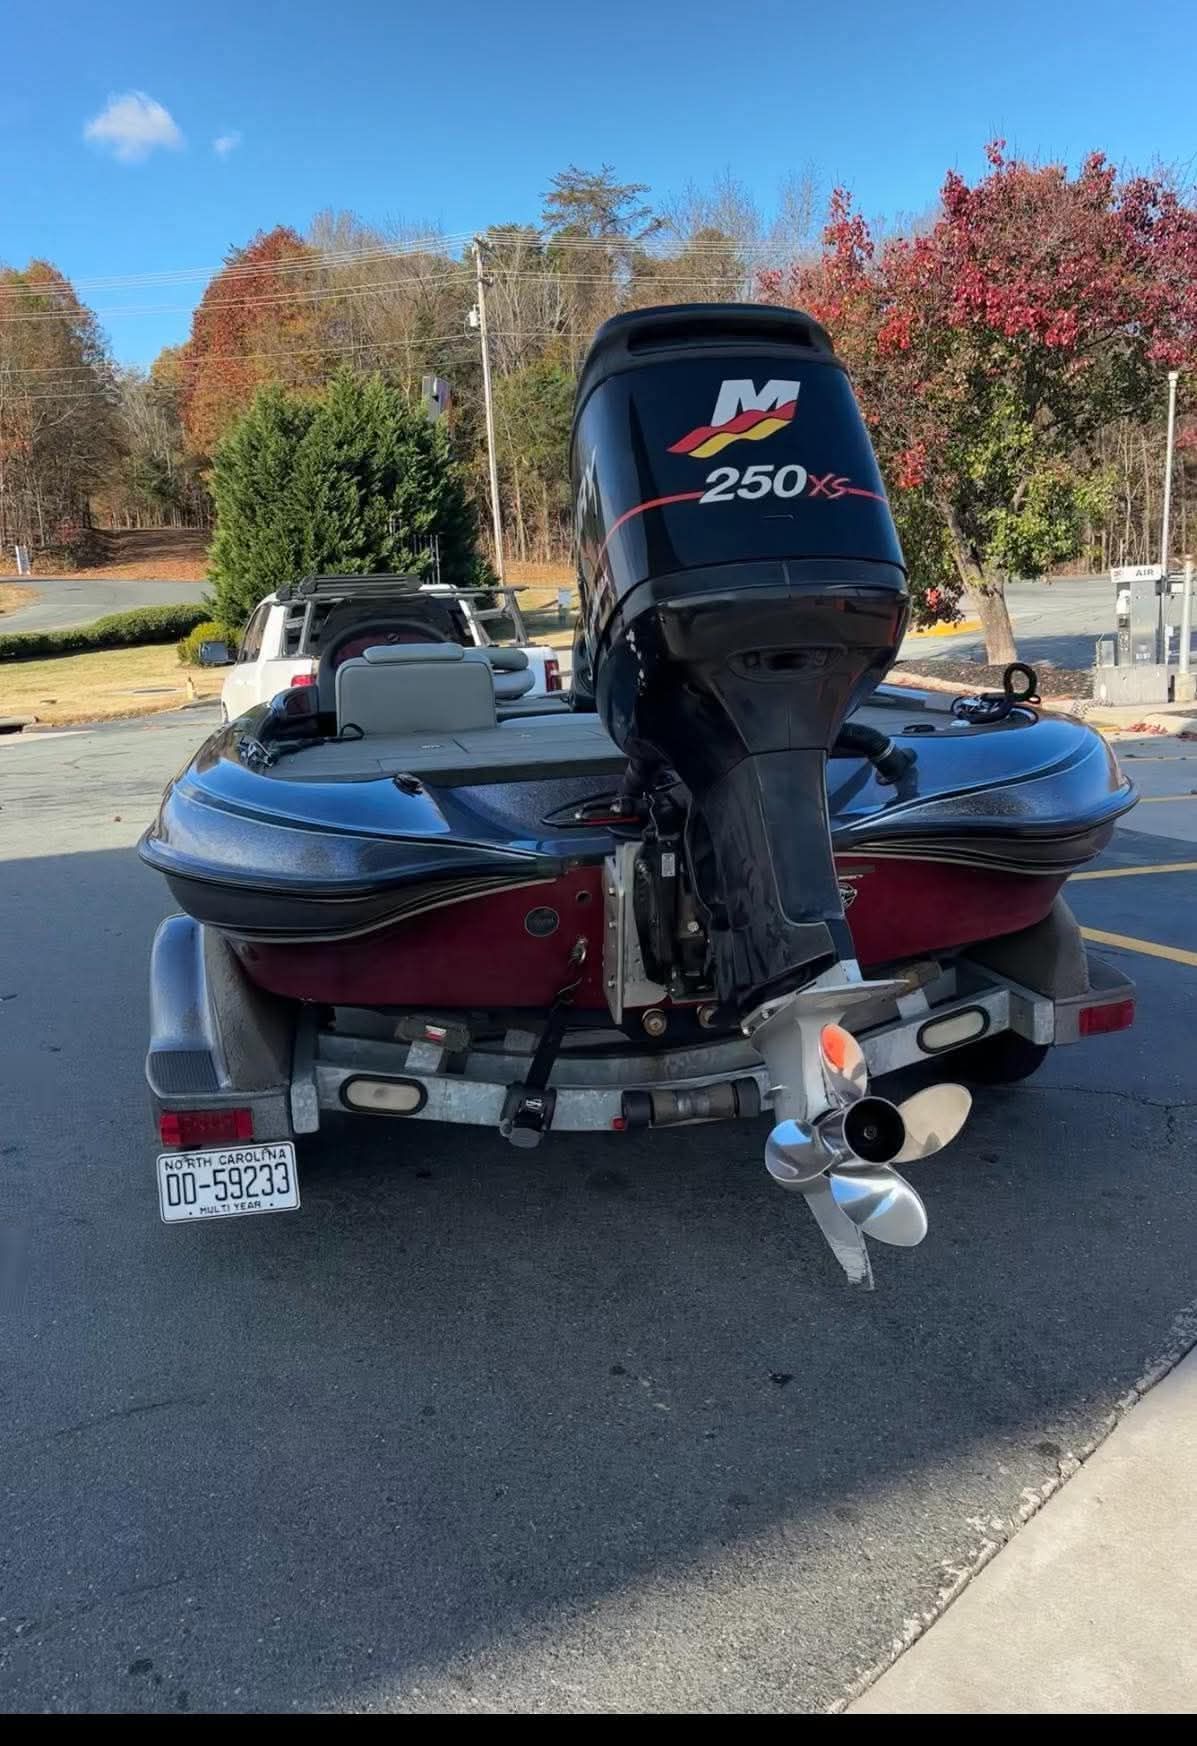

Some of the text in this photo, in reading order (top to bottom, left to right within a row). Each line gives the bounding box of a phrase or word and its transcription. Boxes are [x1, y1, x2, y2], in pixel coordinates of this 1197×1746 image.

[700, 465, 807, 504] 250
[165, 1149, 286, 1170] NORTH CAROLINA
[200, 1201, 261, 1214] MULTI YEAR
